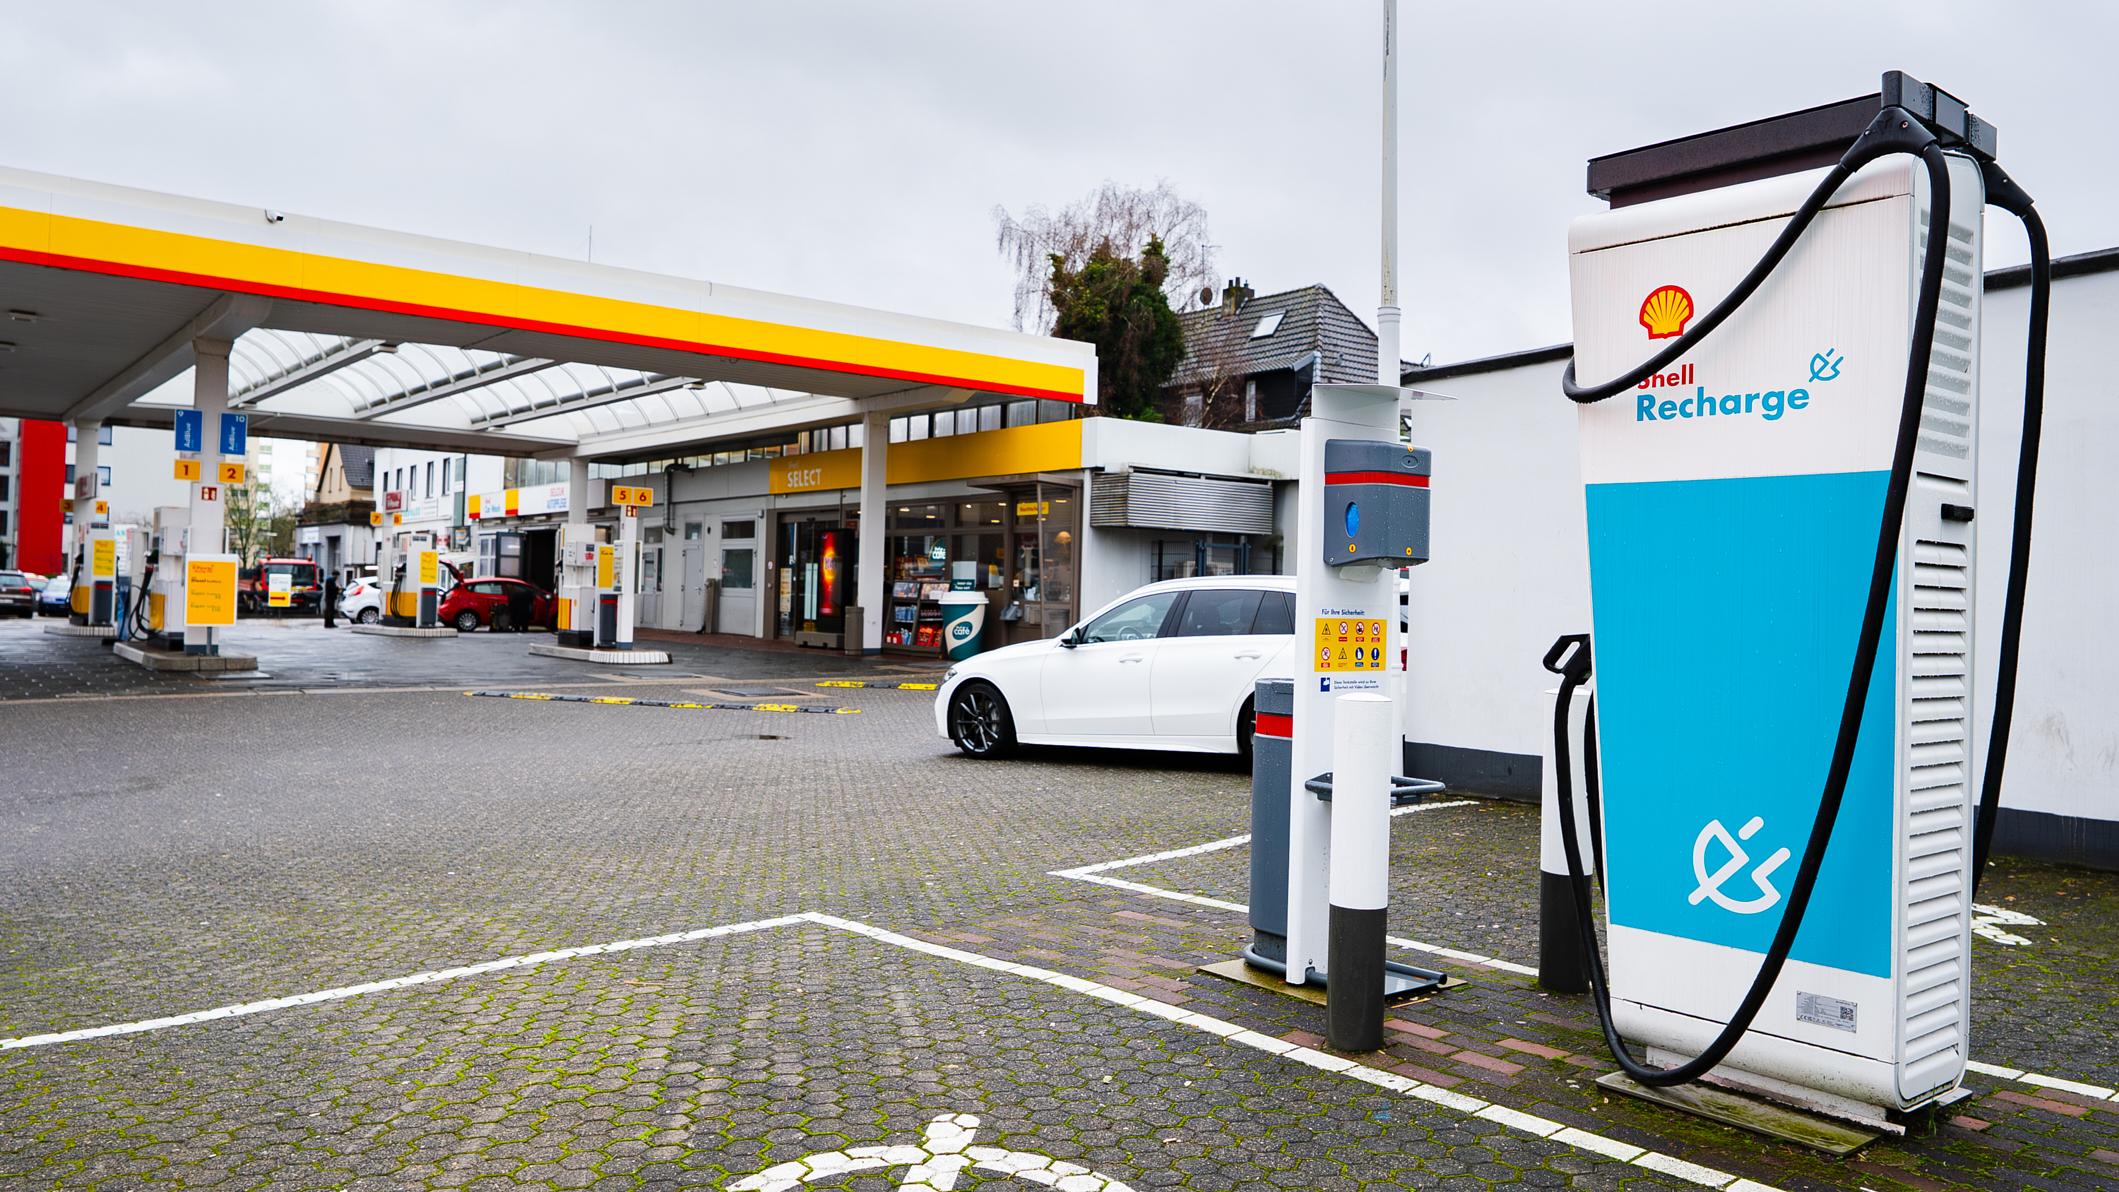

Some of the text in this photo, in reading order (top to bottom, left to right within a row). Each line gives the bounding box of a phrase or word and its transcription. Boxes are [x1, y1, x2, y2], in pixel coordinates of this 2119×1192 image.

[1636, 386, 1810, 421] Recharge
[235, 415, 246, 423] 10
[183, 422, 191, 448] AdBlue
[183, 464, 189, 476] 1
[226, 467, 236, 479] 2
[787, 468, 822, 488] SELECT
[619, 490, 626, 500] 5
[639, 491, 647, 502] 6
